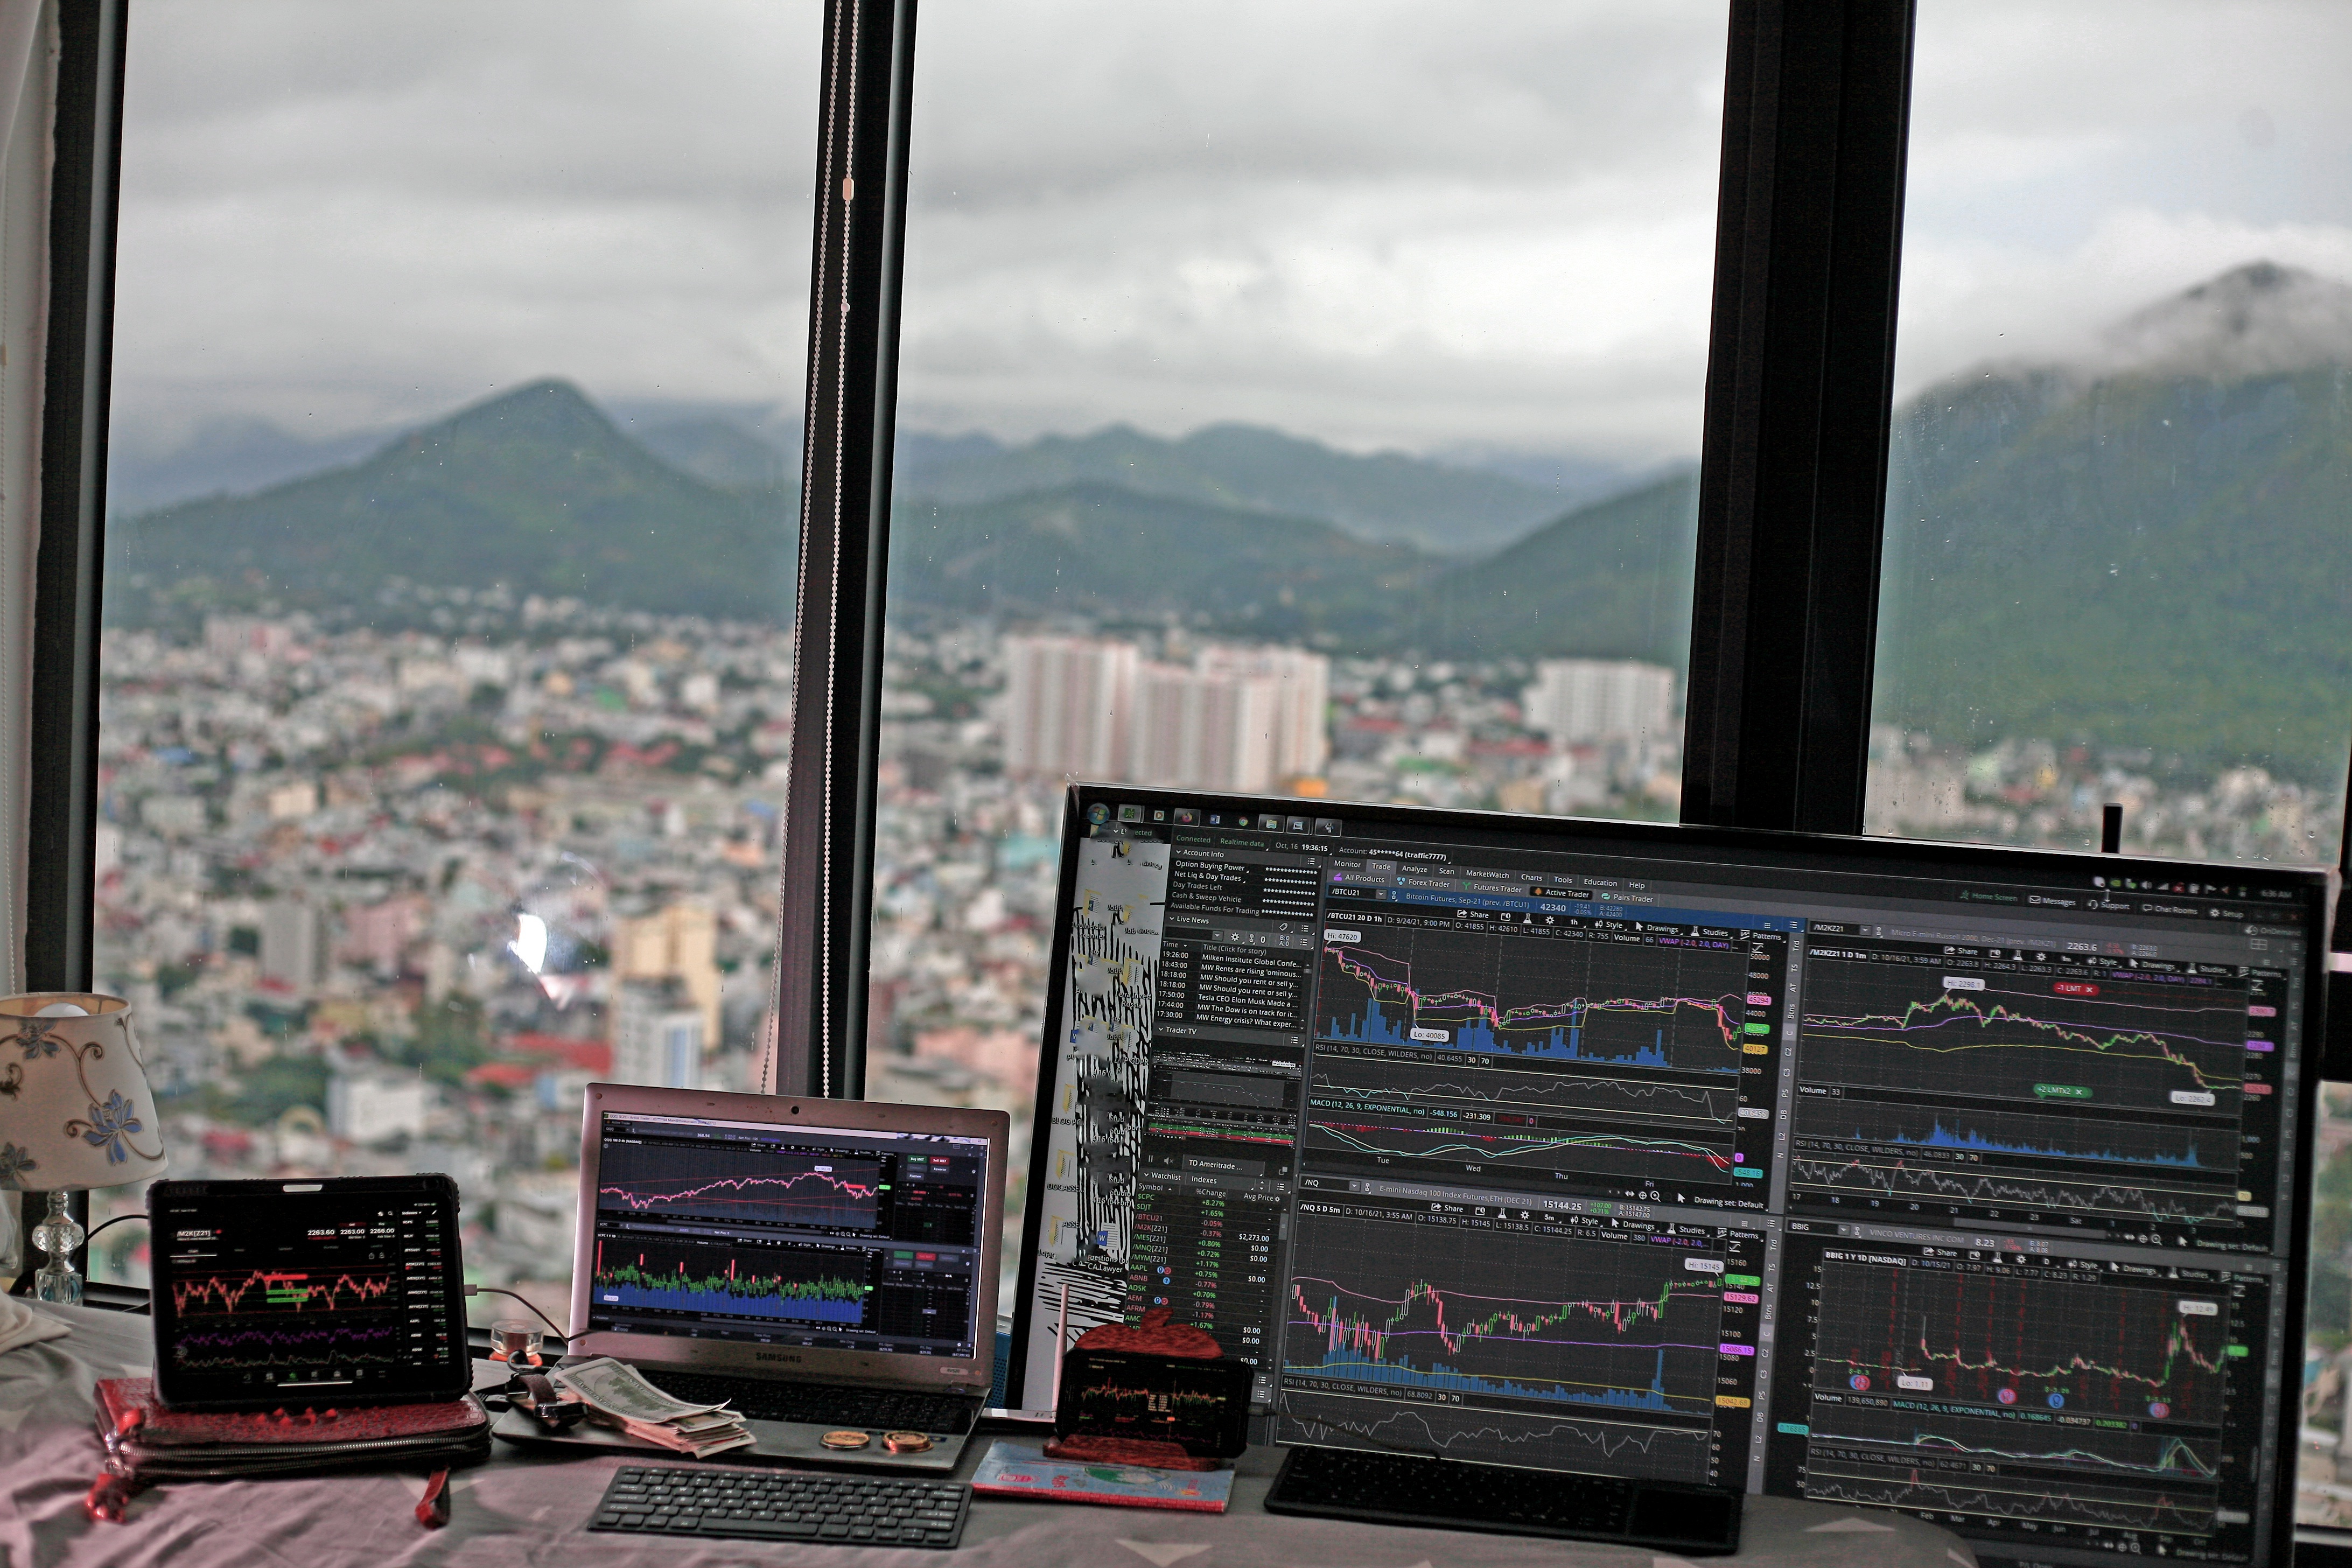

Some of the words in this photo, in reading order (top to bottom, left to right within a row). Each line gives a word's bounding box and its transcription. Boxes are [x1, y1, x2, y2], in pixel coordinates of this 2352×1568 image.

[1221, 838, 1248, 846] Realtime
[1183, 849, 1210, 857] Account
[1211, 850, 1224, 858] Info
[1405, 852, 1446, 861] (traffic7777)
[1176, 860, 1198, 869] Option
[1200, 862, 1222, 871] Buying
[1402, 865, 1427, 874] Analyze
[1188, 872, 1197, 880] Liq
[1206, 873, 1219, 881] Day
[1466, 870, 1509, 878] MarketWatch
[1173, 881, 1186, 890] Day
[1584, 878, 1617, 886] Education
[1629, 882, 1645, 890] Help
[1196, 893, 1217, 902] Sweep
[1431, 895, 1457, 904] Futures,
[1459, 897, 1480, 905] Sep-21
[1502, 900, 1529, 909] /BTCU1)
[1540, 904, 1566, 912] 42340
[2101, 901, 2130, 910] Support
[1236, 907, 1259, 916] Trading
[2222, 910, 2244, 919] Setup
[2067, 942, 2097, 951] 2263.6
[1248, 948, 1266, 956] story)
[1226, 956, 1252, 964] Institute
[1247, 968, 1264, 976] rising
[1210, 1015, 1233, 1024] Energy
[1363, 1048, 1386, 1056] CLOSE,
[1388, 1051, 1419, 1059] WILDERS,
[1364, 1103, 1412, 1115] EXPONENTIAL,
[1199, 1161, 1235, 1170] Ameritrade
[1151, 1172, 1181, 1180] Watchlist
[1305, 1179, 1319, 1187] /NQ
[1403, 1187, 1427, 1197] Nasdaq
[1504, 1196, 1520, 1204] (DEC
[1522, 1198, 1532, 1206] 21)
[1544, 1200, 1581, 1210] 15144.25
[1239, 1234, 1269, 1242] $2,273.00
[1870, 1229, 1893, 1237] VINCO
[1894, 1231, 1931, 1241] VENTURES
[1976, 1238, 1994, 1247] 8.23
[756, 1352, 802, 1363] SAMSUNG
